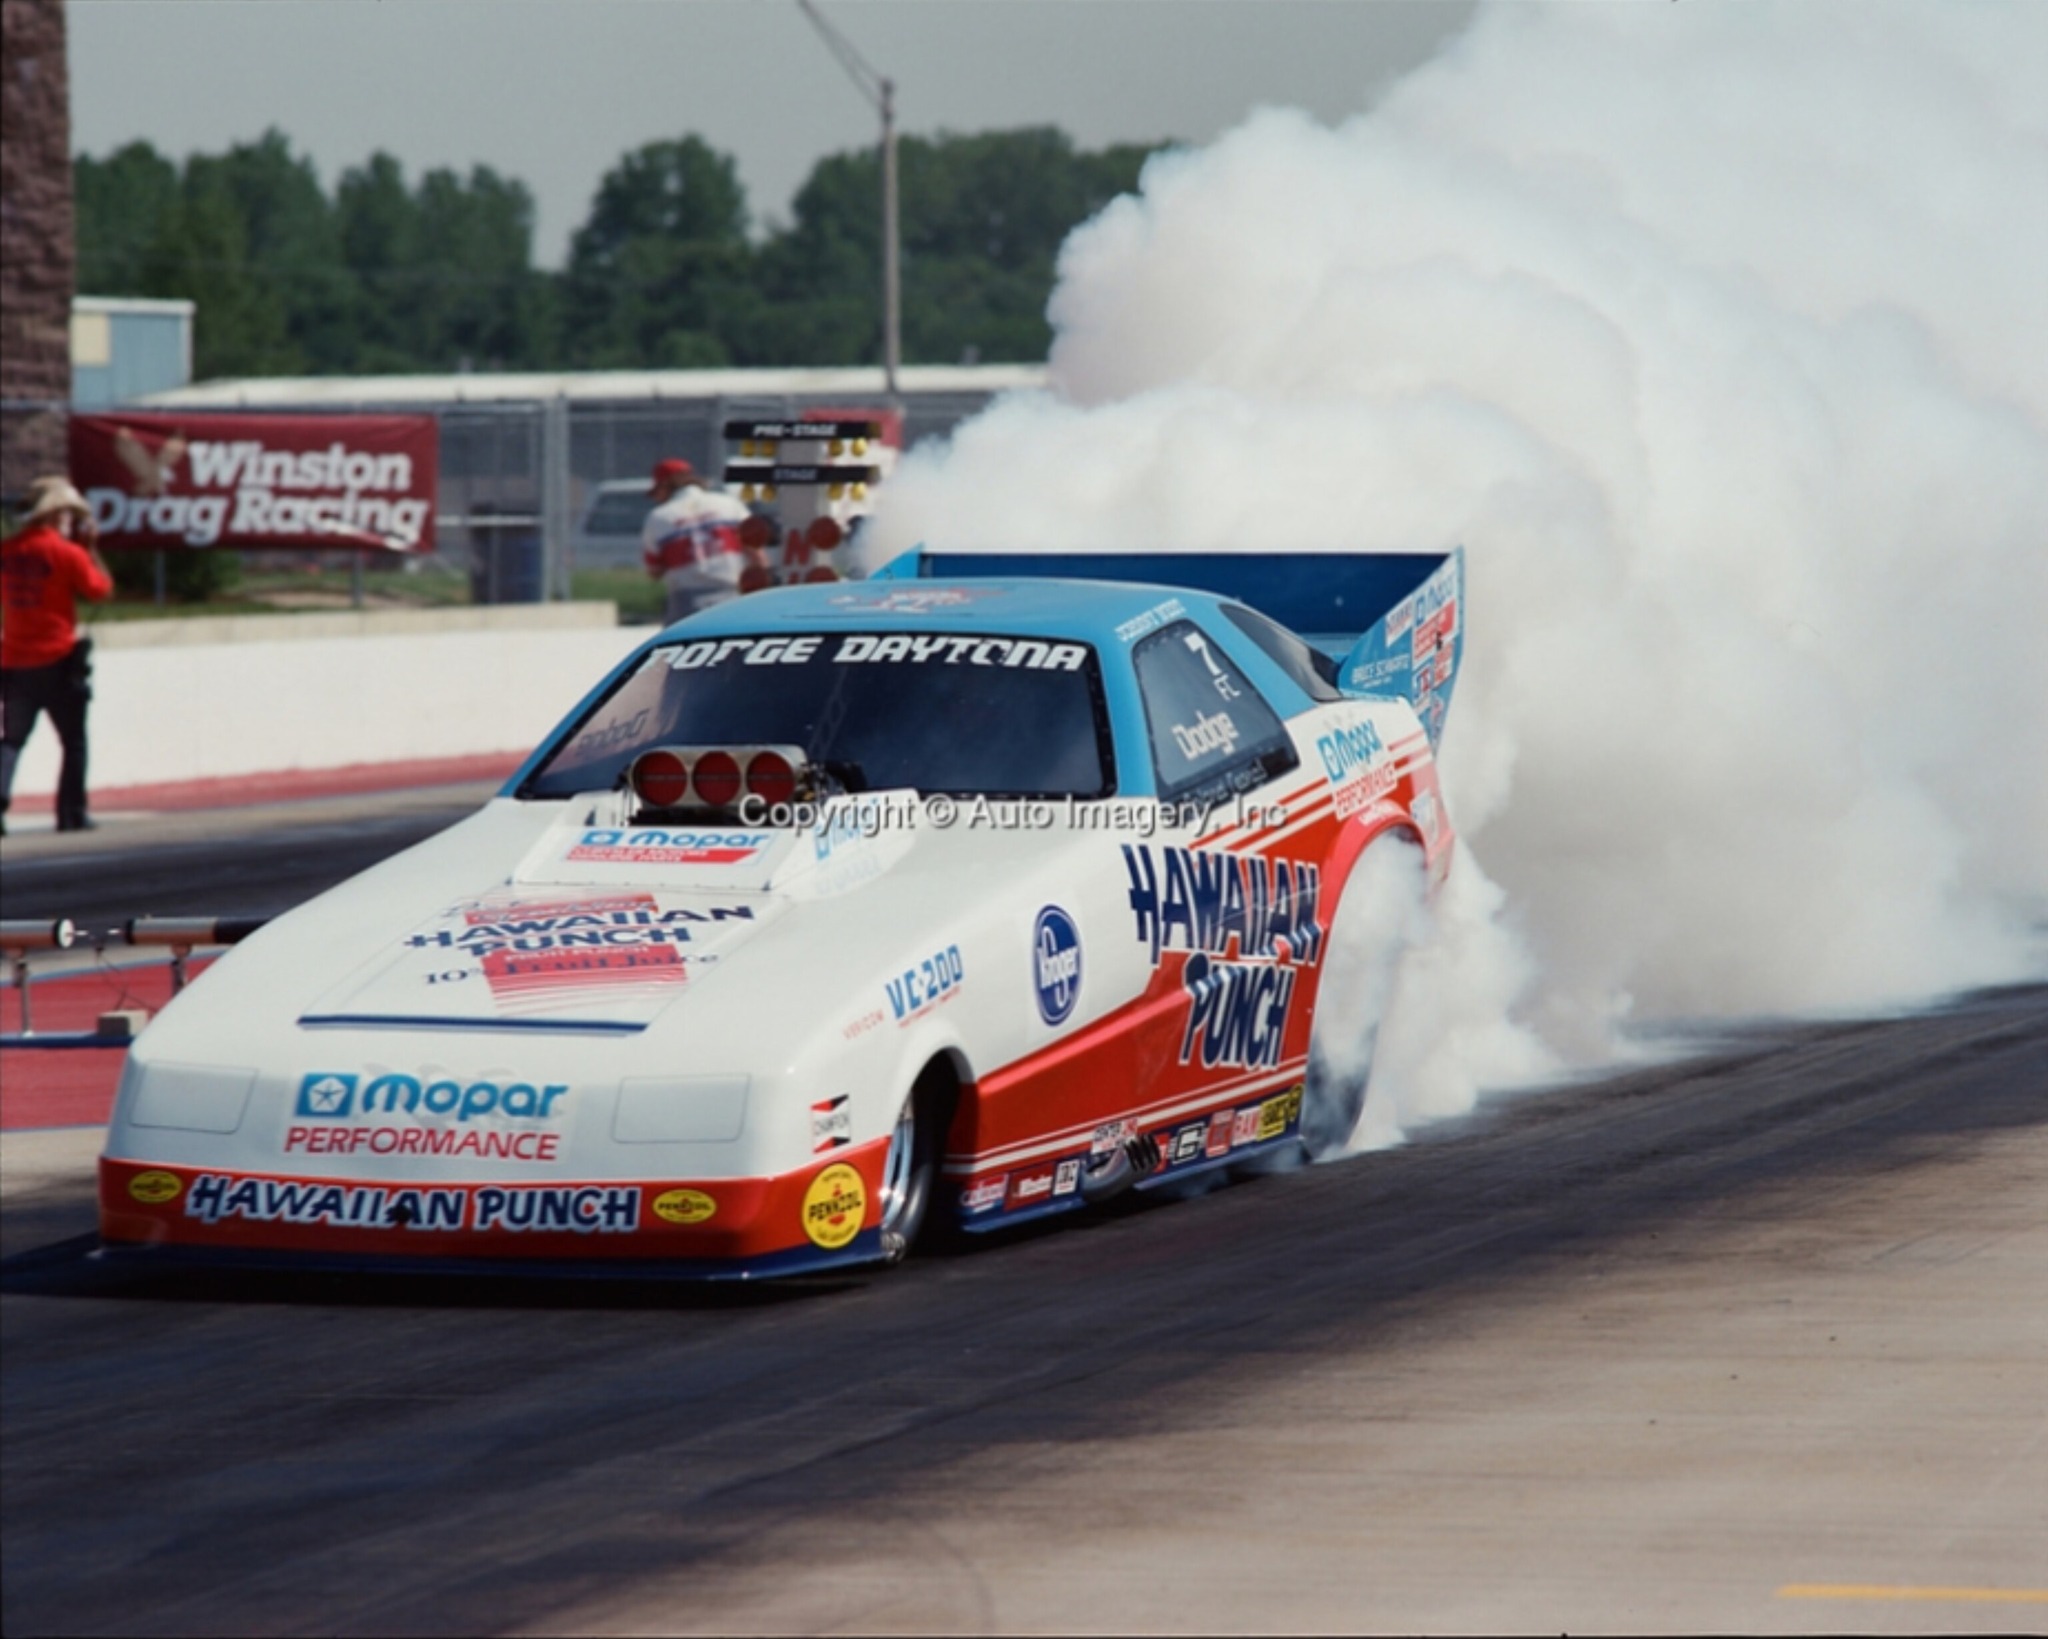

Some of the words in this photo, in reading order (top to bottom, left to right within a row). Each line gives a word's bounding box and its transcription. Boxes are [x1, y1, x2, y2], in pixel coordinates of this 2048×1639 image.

[753, 424, 837, 437] PRE-STAGE
[187, 440, 412, 490] Winston
[85, 488, 227, 546] Drag
[230, 490, 430, 552] Racing
[833, 636, 1087, 671] DAYTONA
[1171, 710, 1240, 760] Dodge
[629, 830, 770, 849] Mopar
[403, 906, 755, 947] HAWAIIAN
[1120, 844, 1322, 969] HAWAIIAN
[458, 927, 691, 958] PUNCH
[884, 943, 964, 1020] VC-200
[1178, 953, 1297, 1071] PUNCH
[362, 1073, 570, 1122] Mopar
[284, 1126, 561, 1161] PERFORMANCE
[184, 1174, 466, 1231] HAWAIIAN
[473, 1185, 642, 1233] PUNCH
